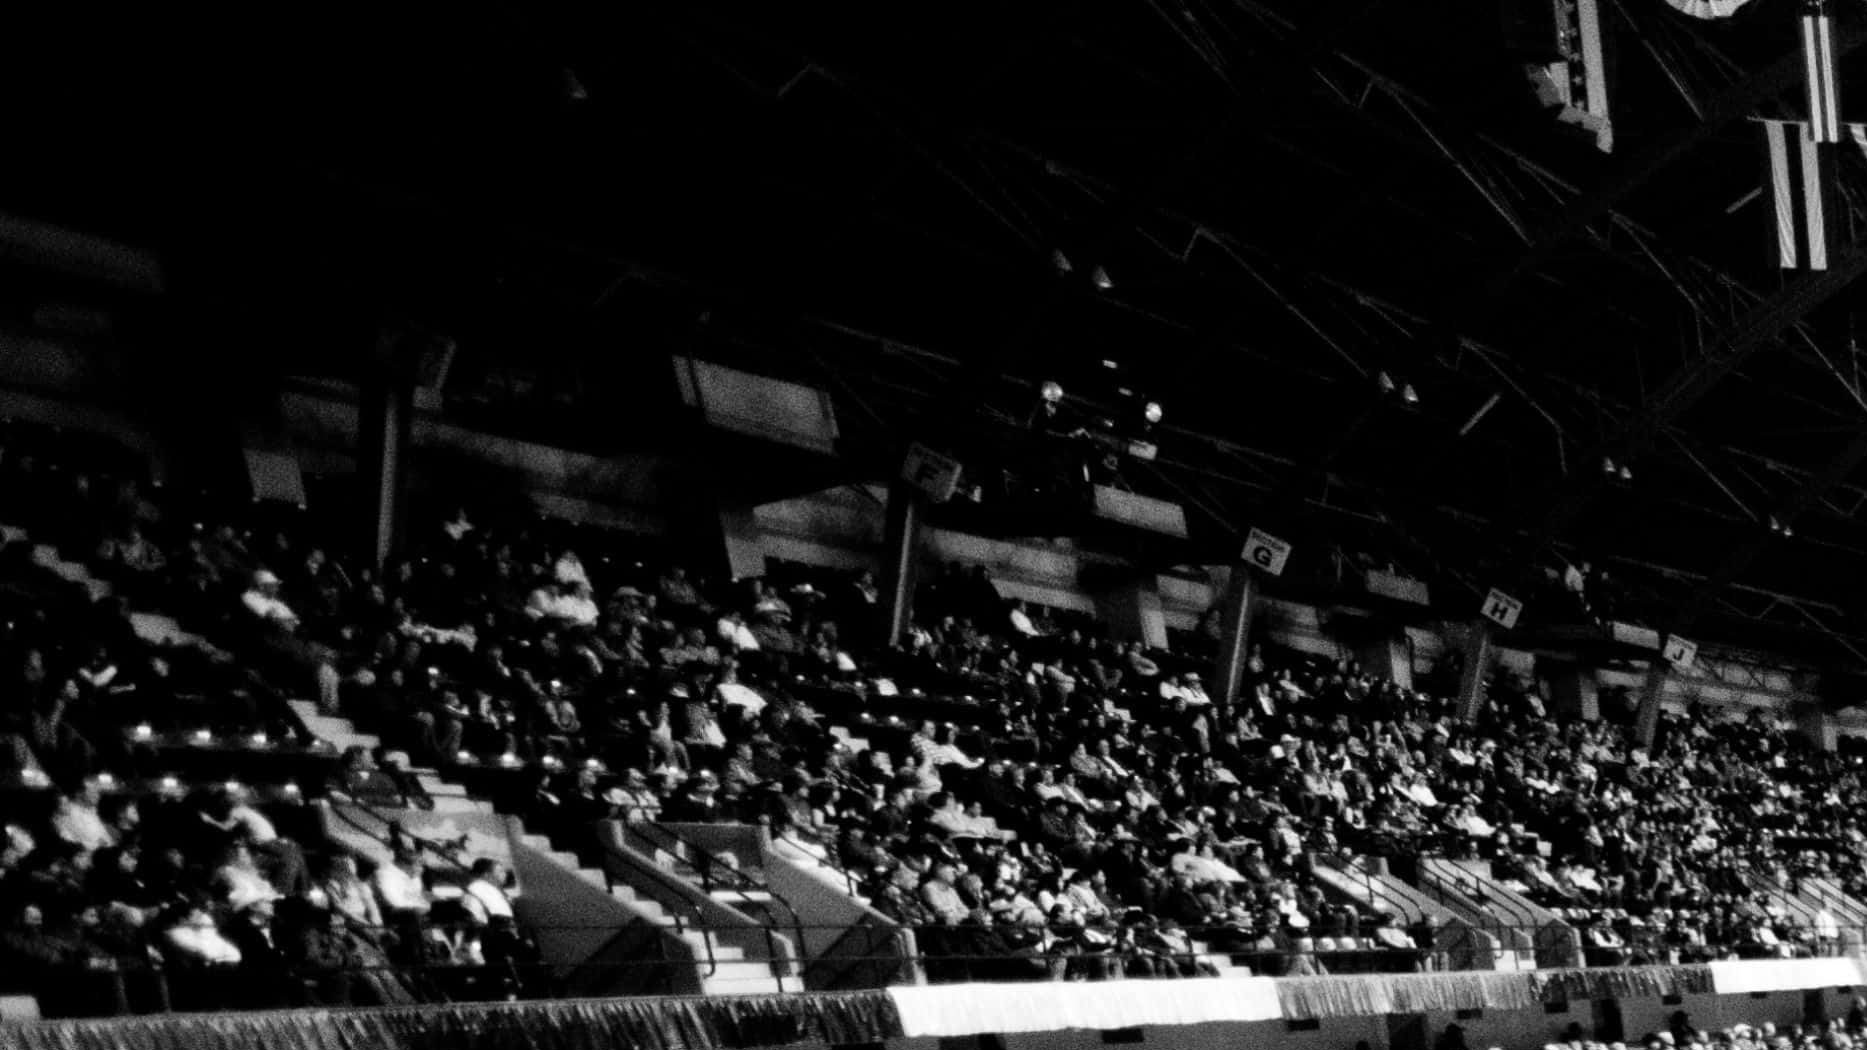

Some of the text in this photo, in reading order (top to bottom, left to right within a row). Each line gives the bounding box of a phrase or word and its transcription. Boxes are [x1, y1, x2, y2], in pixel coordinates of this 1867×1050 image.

[1253, 546, 1273, 568] G
[1490, 601, 1510, 621] H
[1672, 647, 1685, 661] J
